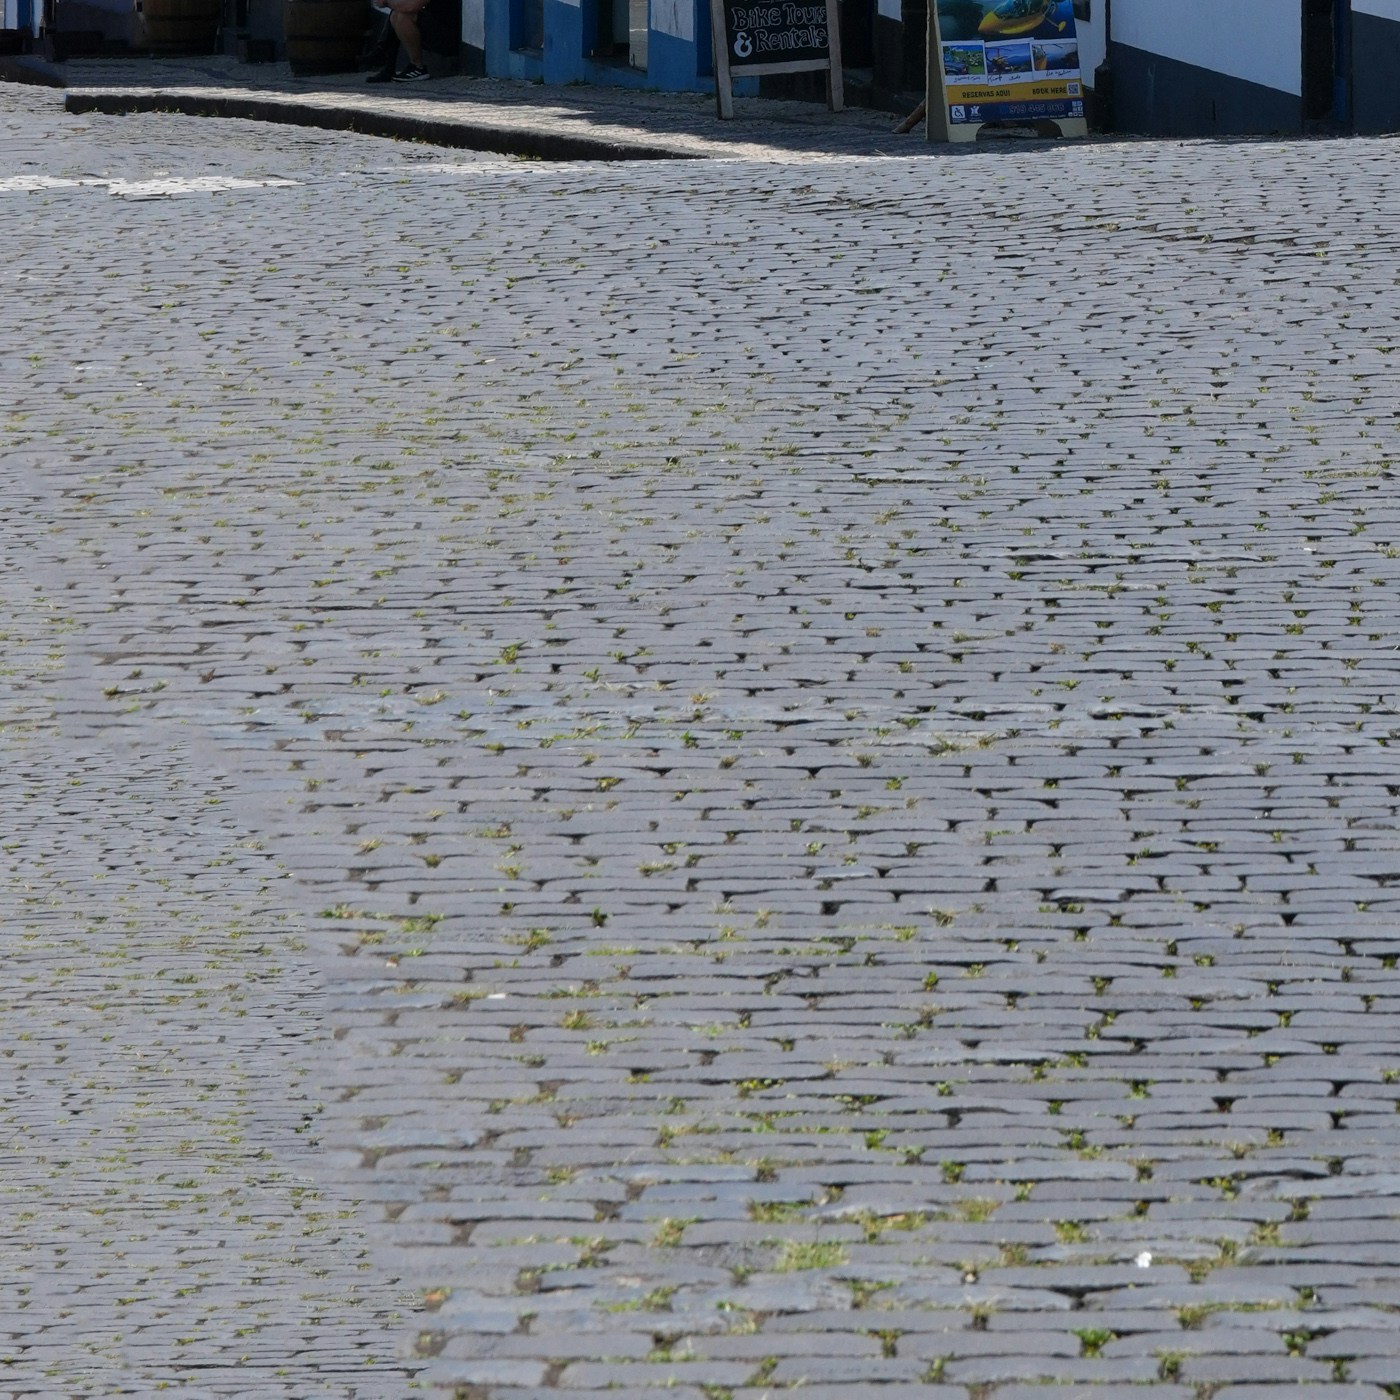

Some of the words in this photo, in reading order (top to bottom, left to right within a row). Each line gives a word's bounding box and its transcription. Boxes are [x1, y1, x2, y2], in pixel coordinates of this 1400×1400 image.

[731, 7, 782, 32] Bike
[782, 3, 828, 26] Tours
[733, 32, 753, 58] &
[754, 26, 829, 53] Rentals
[961, 90, 995, 99] RESERVAS
[1031, 87, 1050, 96] BOOK
[1050, 86, 1067, 95] HERE
